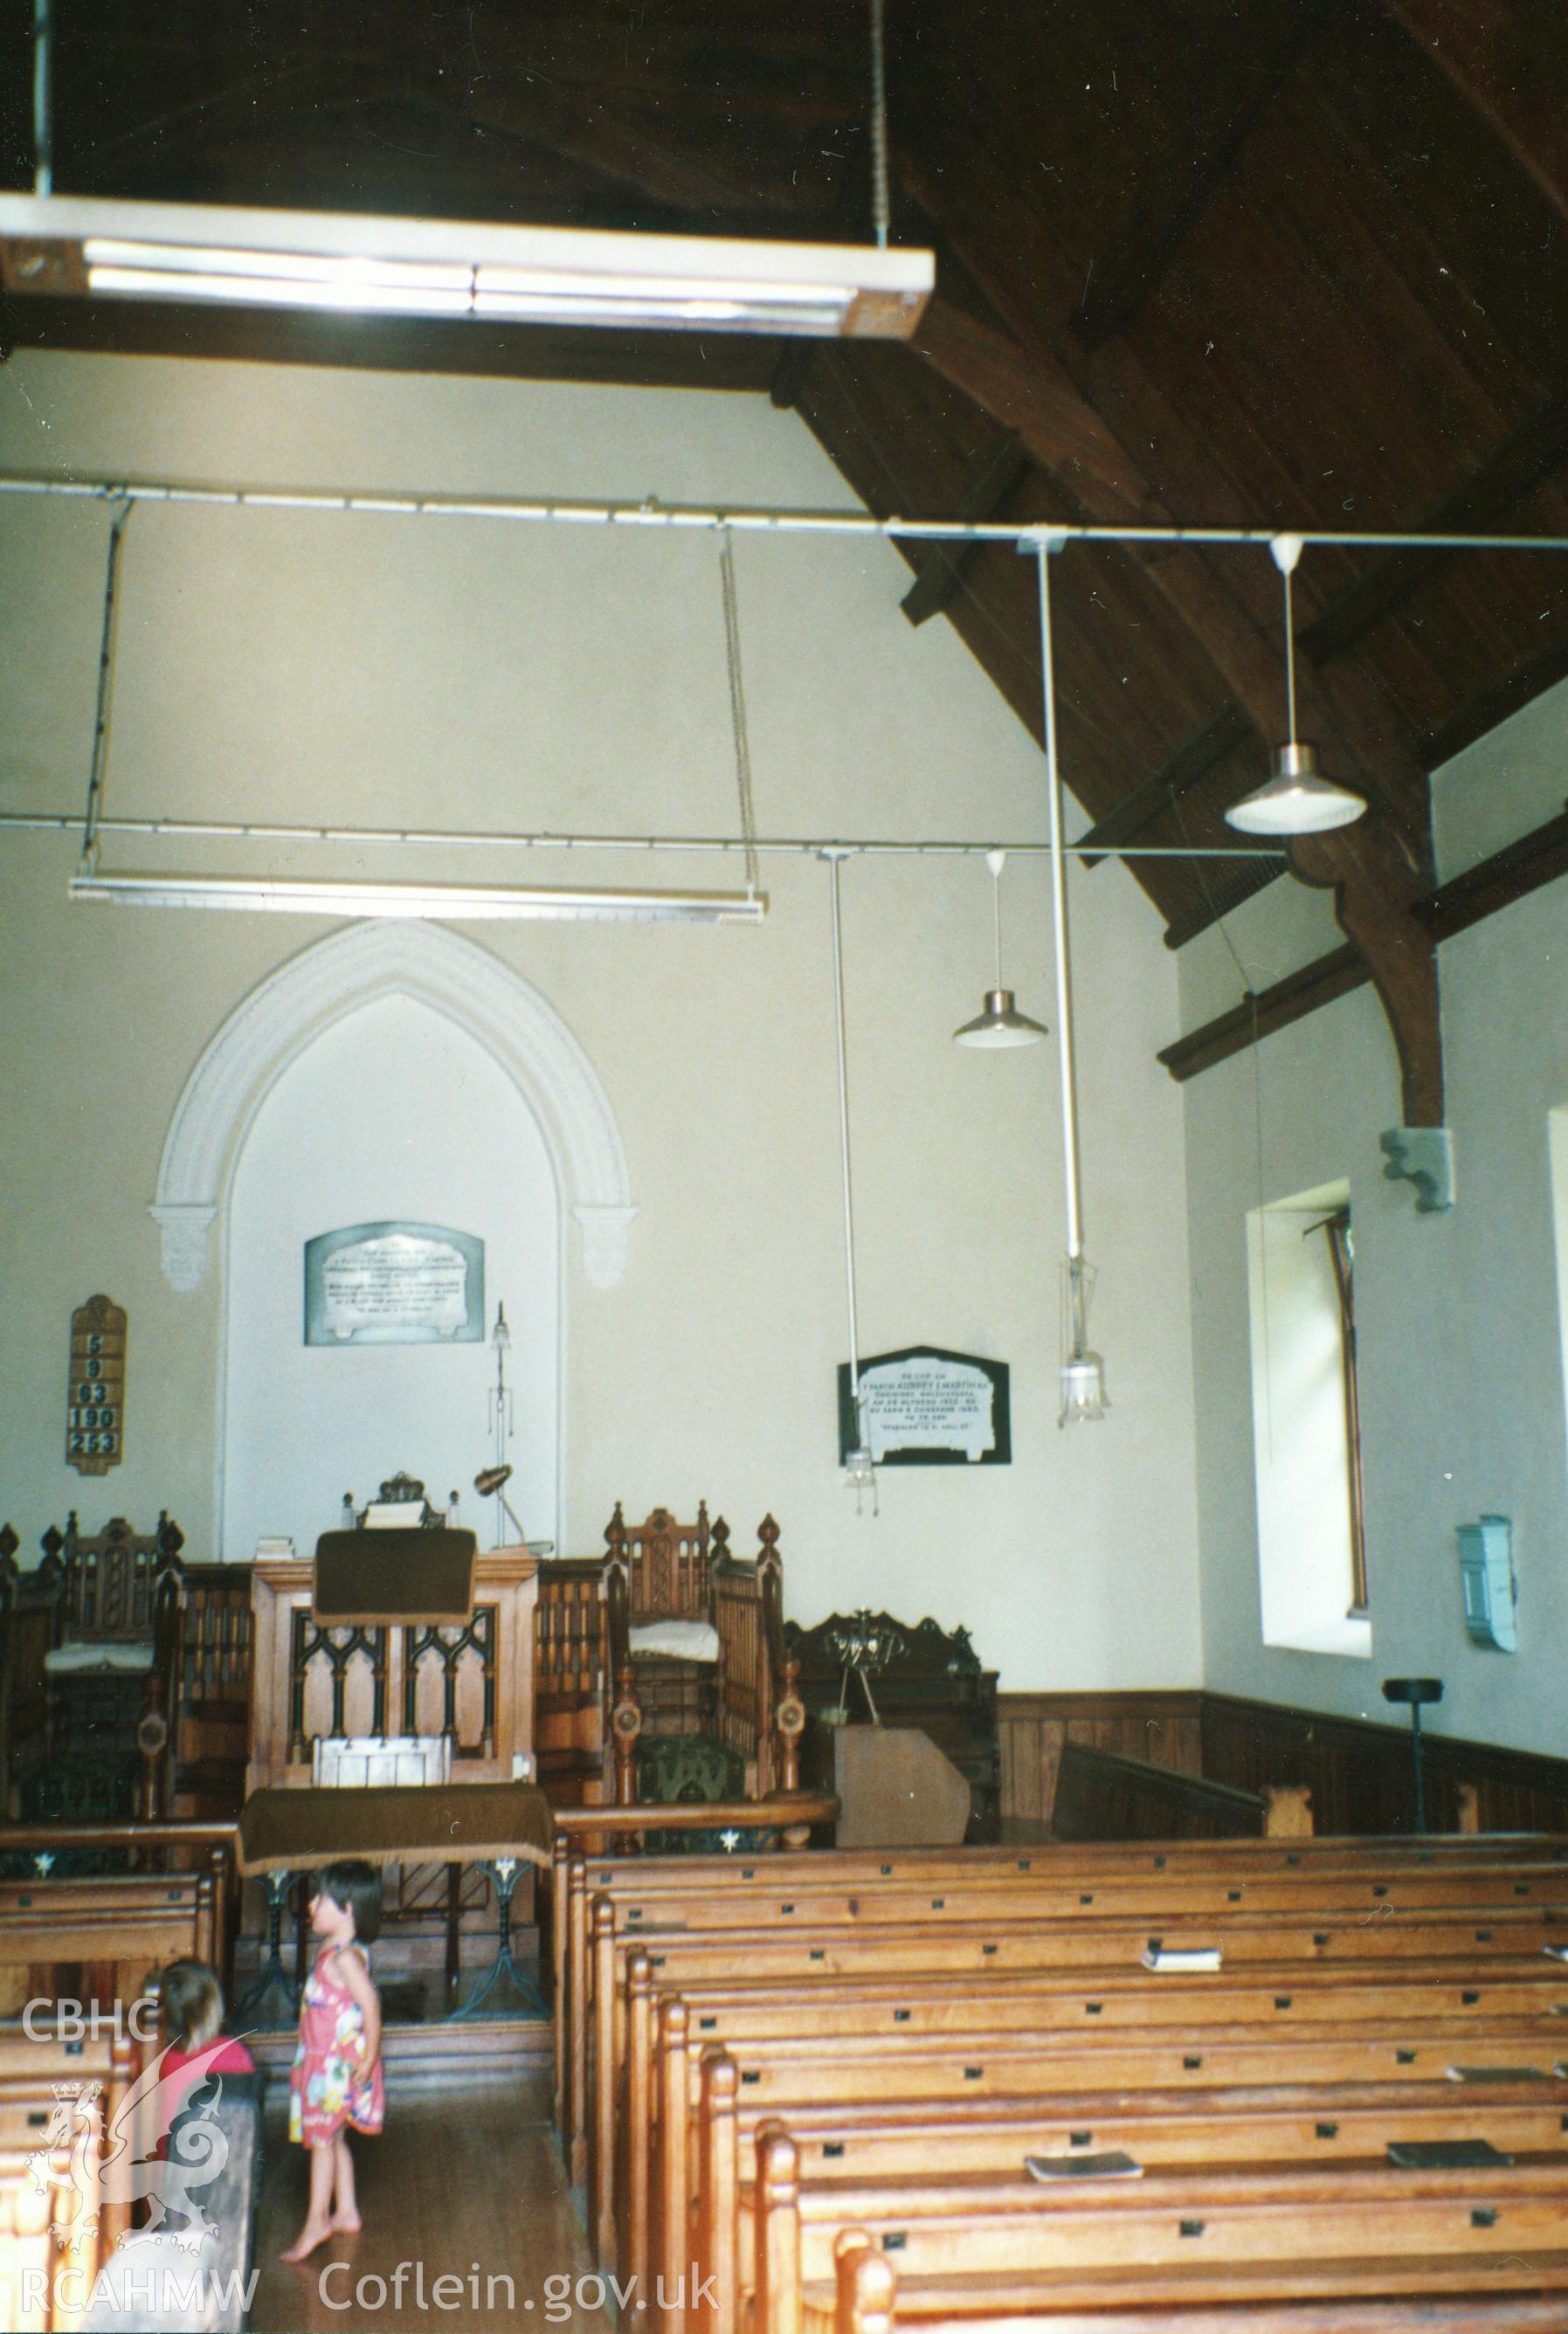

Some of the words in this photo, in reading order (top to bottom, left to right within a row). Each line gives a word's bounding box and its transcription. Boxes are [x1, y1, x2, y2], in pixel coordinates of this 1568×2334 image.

[89, 1336, 100, 1354] 5
[88, 1359, 100, 1378] 9
[79, 1384, 107, 1403] 63
[943, 1381, 976, 1390] MARTIN
[73, 1407, 114, 1428] 190
[72, 1433, 114, 1454] 253
